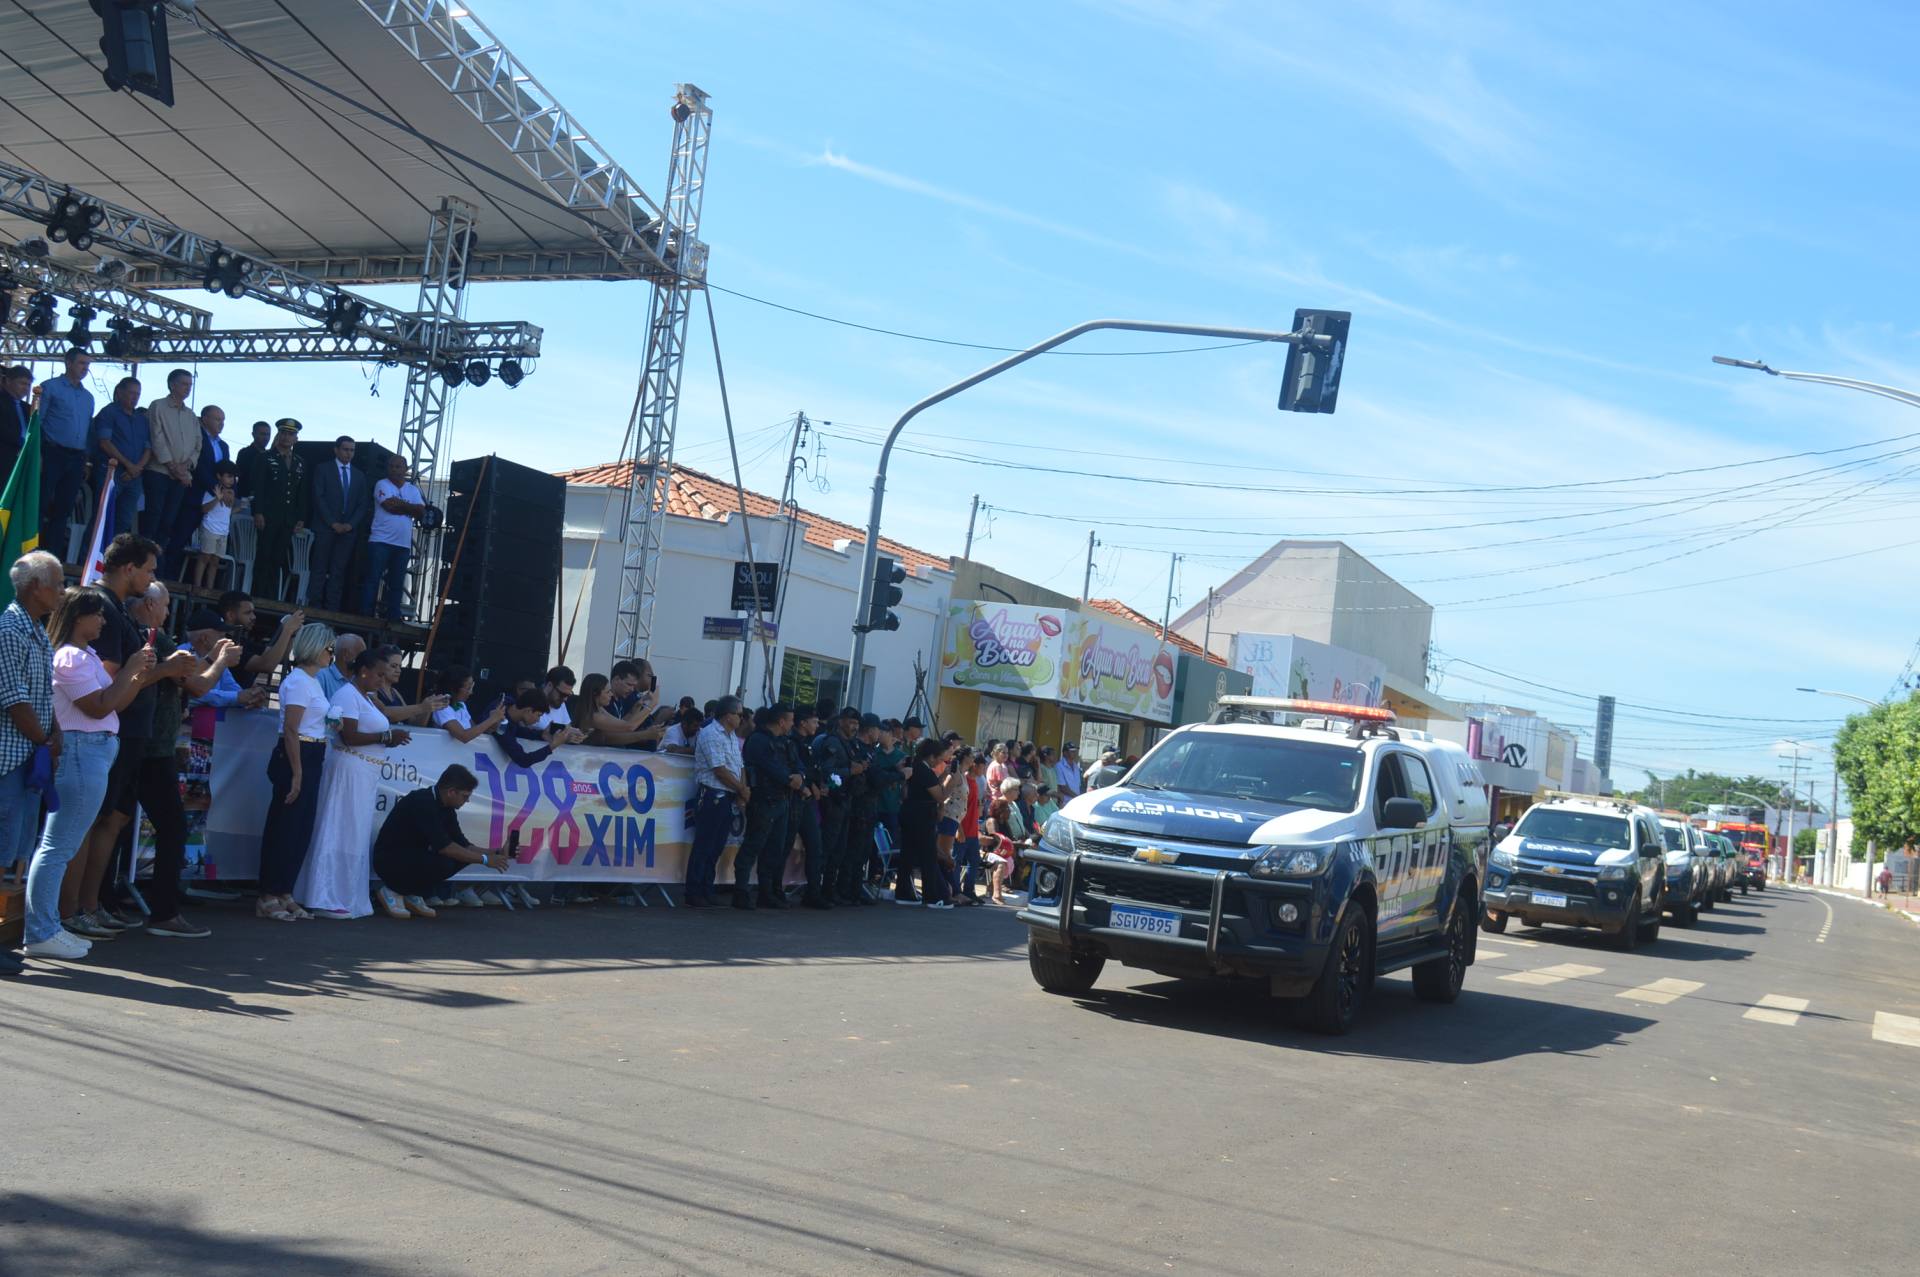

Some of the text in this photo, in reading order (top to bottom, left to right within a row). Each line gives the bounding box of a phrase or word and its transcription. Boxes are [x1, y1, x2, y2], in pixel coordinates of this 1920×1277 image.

[976, 640, 1035, 667] Boca
[1009, 639, 1025, 649] na
[381, 755, 423, 786] ória,
[572, 783, 592, 793] anos
[598, 761, 656, 814] CO
[475, 752, 580, 865] 128
[582, 813, 656, 868] XIM
[1116, 913, 1173, 934] SGV9B95
